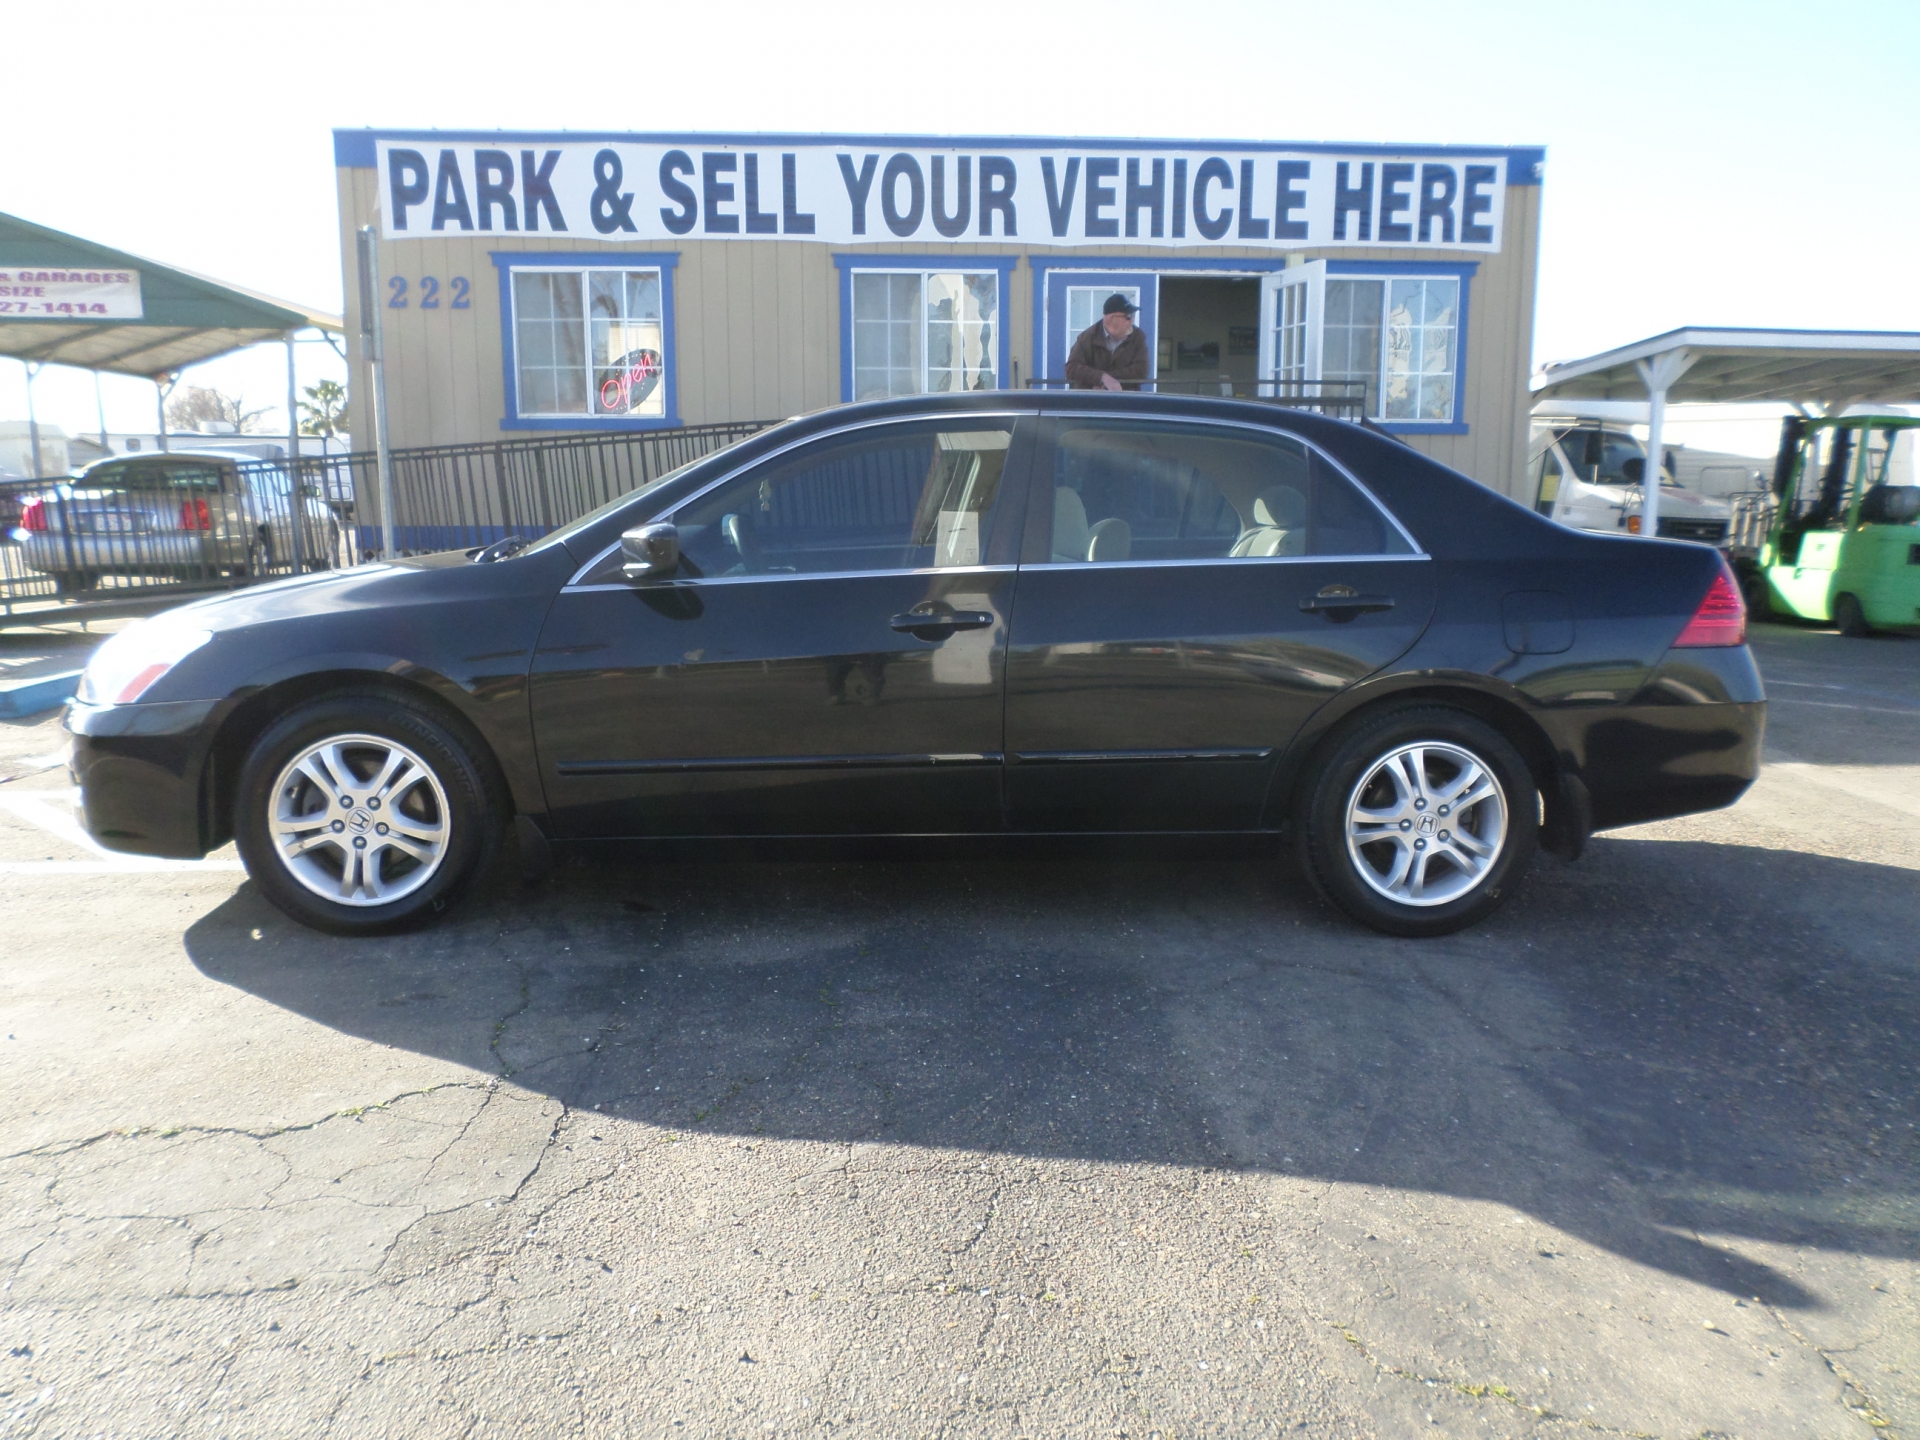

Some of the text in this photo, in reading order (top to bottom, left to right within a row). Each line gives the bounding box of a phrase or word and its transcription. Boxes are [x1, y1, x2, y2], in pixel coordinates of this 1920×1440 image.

[388, 148, 1497, 244] PARK & SELL YOUR VEHICLE HERE
[18, 271, 130, 284] GARAGES
[0, 286, 46, 297] SIZE
[388, 275, 470, 309] 222
